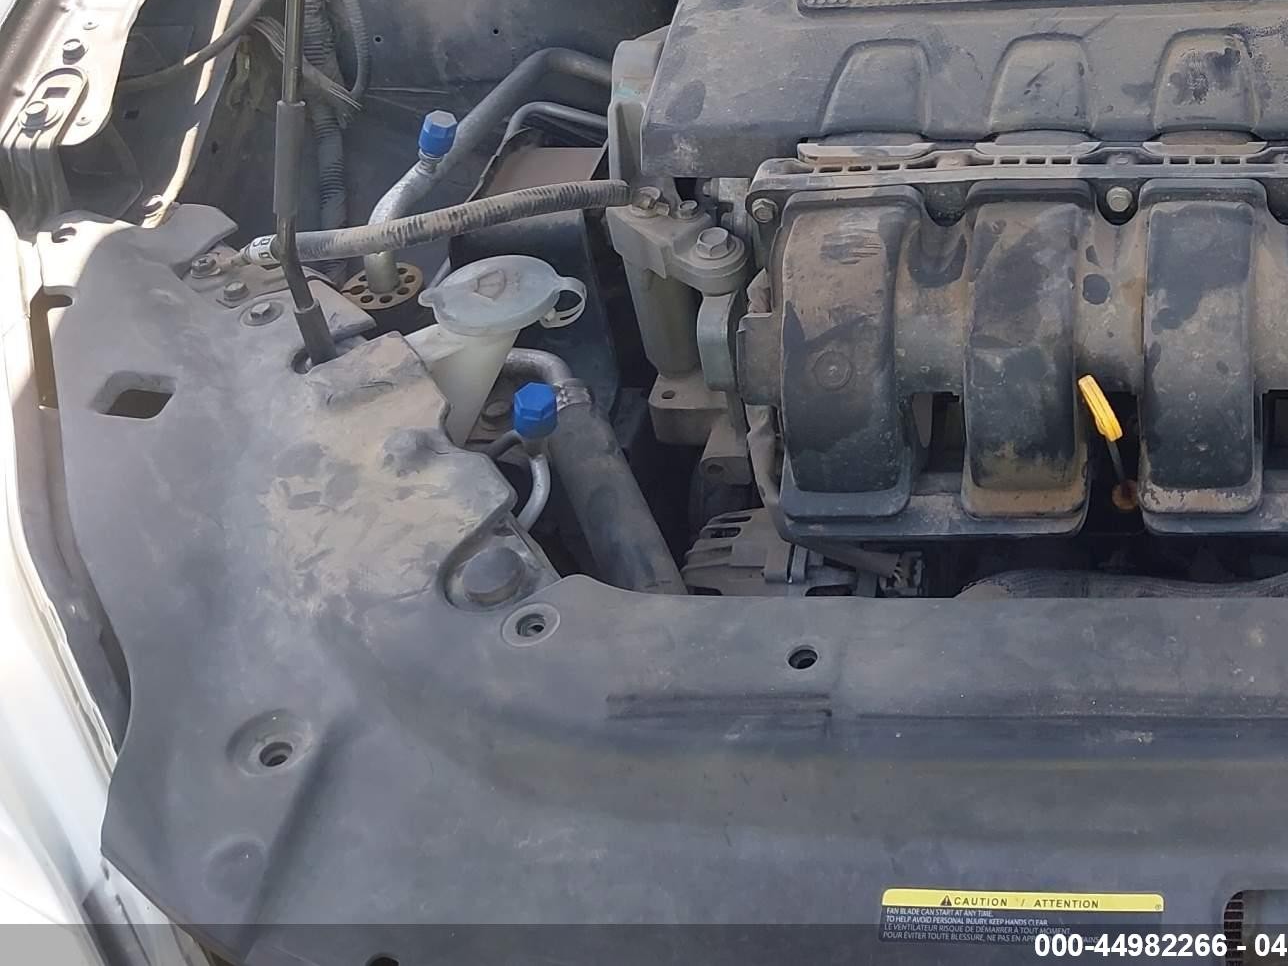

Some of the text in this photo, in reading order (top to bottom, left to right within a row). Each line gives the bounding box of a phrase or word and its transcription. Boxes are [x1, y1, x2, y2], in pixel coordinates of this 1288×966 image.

[953, 897, 1008, 907] CAUTION
[1033, 899, 1099, 909] ATTENTION
[886, 907, 899, 915] FAN
[900, 907, 920, 915] BLADE
[921, 908, 934, 916] CAN
[886, 915, 895, 923] TO
[912, 916, 932, 924] AVOID
[933, 917, 964, 925] PERSONAL
[893, 923, 937, 932] VENTILATEUR
[939, 925, 963, 933] RISQUE
[965, 925, 975, 933] DE
[883, 930, 902, 939] POUR
[928, 932, 949, 940] TOUTE
[987, 934, 996, 942] NE
[998, 934, 1010, 943] PAS
[1011, 934, 1021, 943] EN
